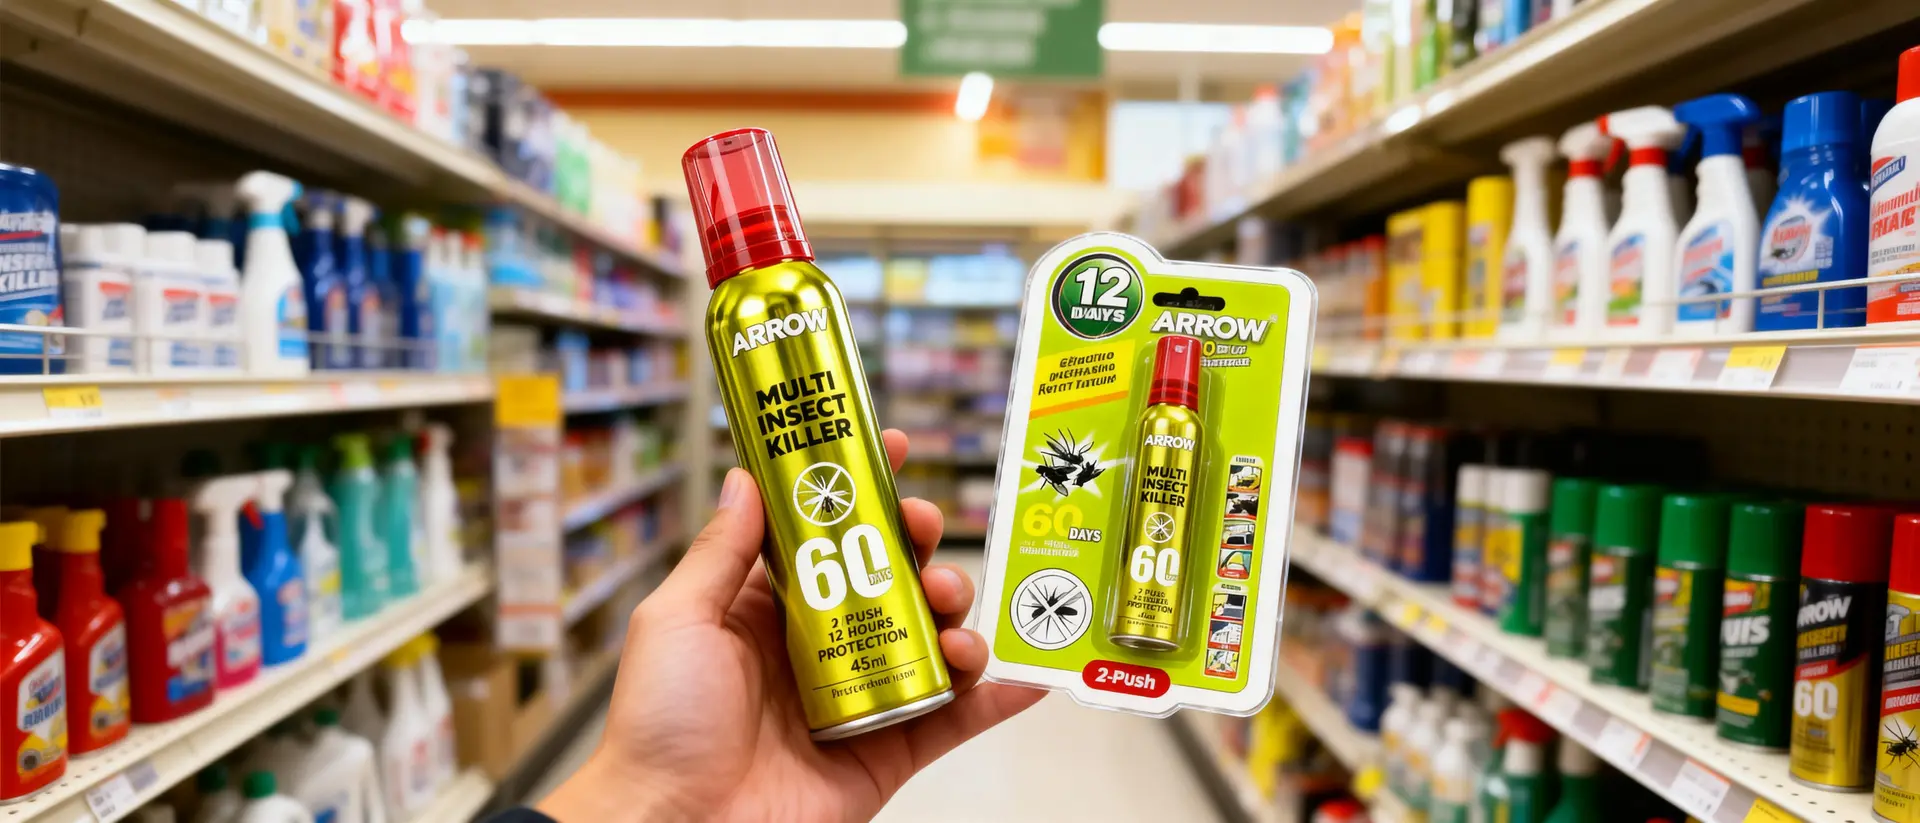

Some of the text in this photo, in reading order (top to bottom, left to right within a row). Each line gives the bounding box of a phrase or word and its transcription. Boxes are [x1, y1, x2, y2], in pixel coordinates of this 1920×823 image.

[1076, 266, 1131, 308] 12
[732, 307, 828, 358] ARROW
[1150, 310, 1269, 342] ARROW
[756, 371, 836, 411] MULTI
[757, 393, 846, 436] INSECT
[765, 418, 854, 460] KILLER
[1144, 434, 1195, 451] ARROW
[1142, 478, 1188, 494] INSECT
[1146, 465, 1187, 481] MULTI
[1140, 491, 1185, 508] KILLER
[1022, 503, 1102, 543] 60 DAYS
[794, 524, 894, 612] 60
[1130, 544, 1180, 587] 60
[828, 616, 894, 644] 12 HOURS
[831, 606, 883, 629] 2 PUSH
[818, 627, 909, 663] PROTECTION
[850, 653, 888, 673] 45ml
[1094, 666, 1157, 690] 2-Push
[1793, 680, 1838, 721] 60
